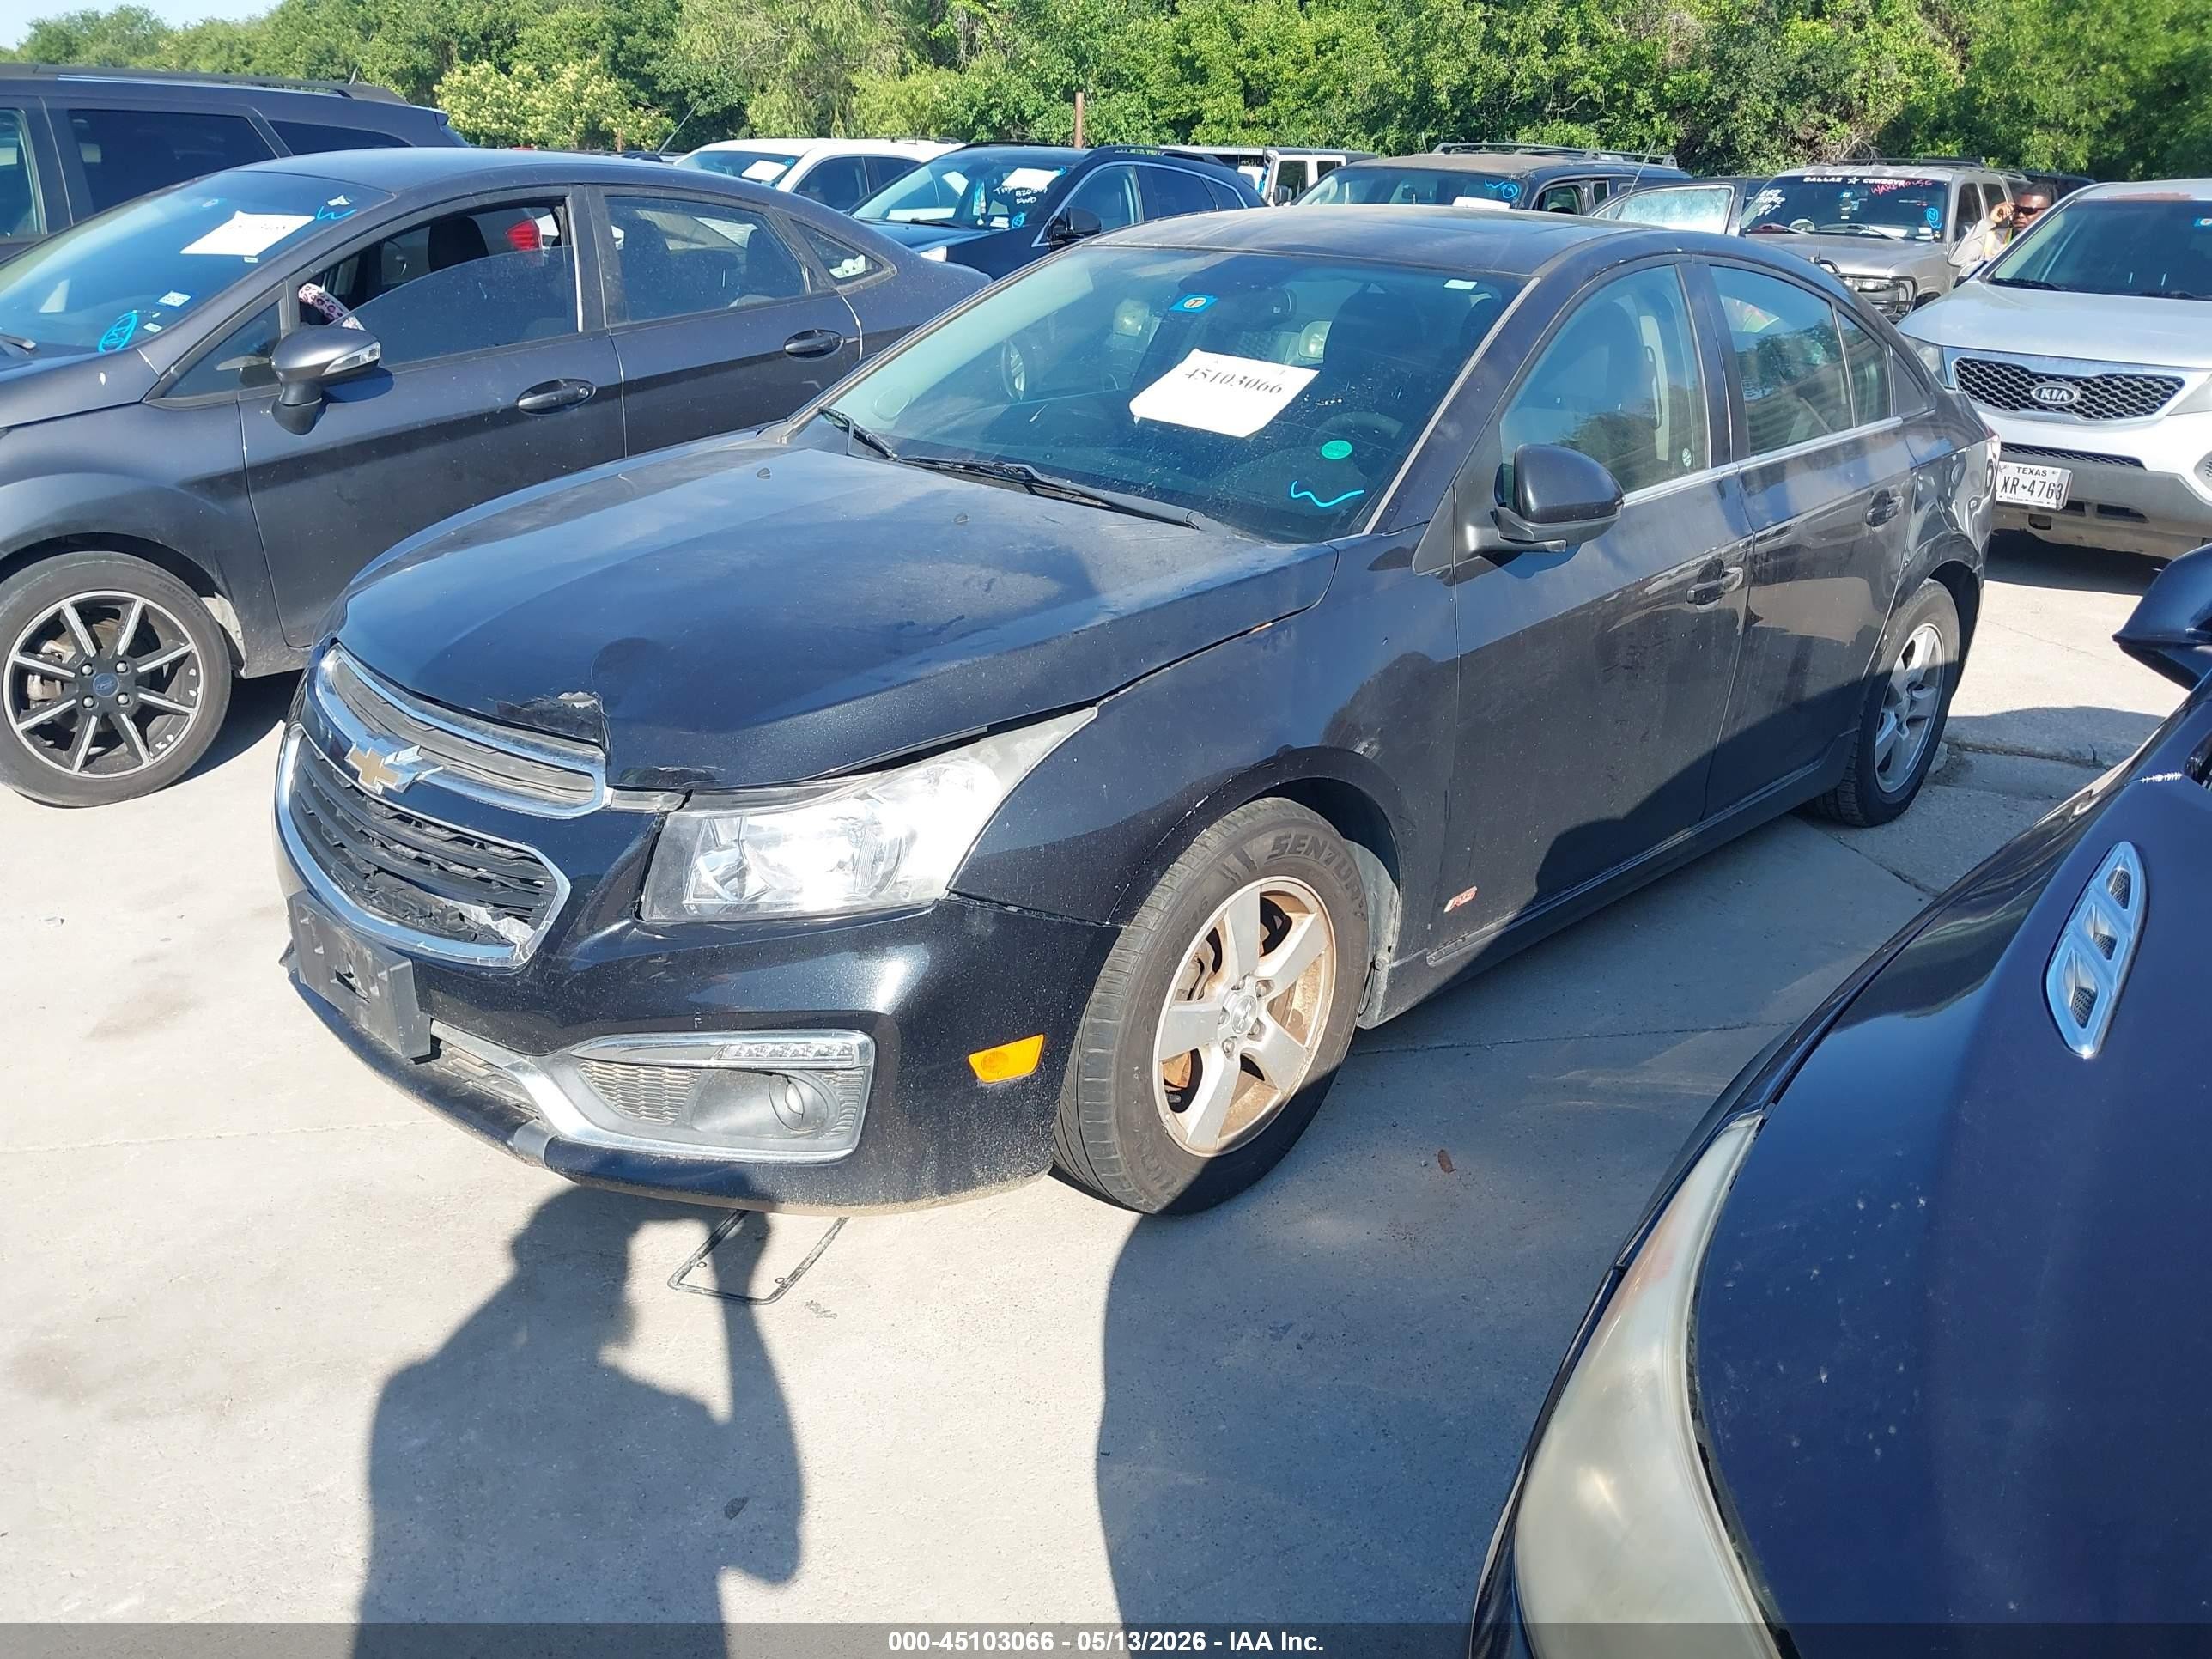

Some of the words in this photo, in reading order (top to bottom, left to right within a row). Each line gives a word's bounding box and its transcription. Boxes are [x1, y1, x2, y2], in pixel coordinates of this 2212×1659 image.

[2039, 388, 2069, 402] KIA
[2016, 466, 2048, 477] TEXAS
[1266, 832, 1368, 921] SENTURY
